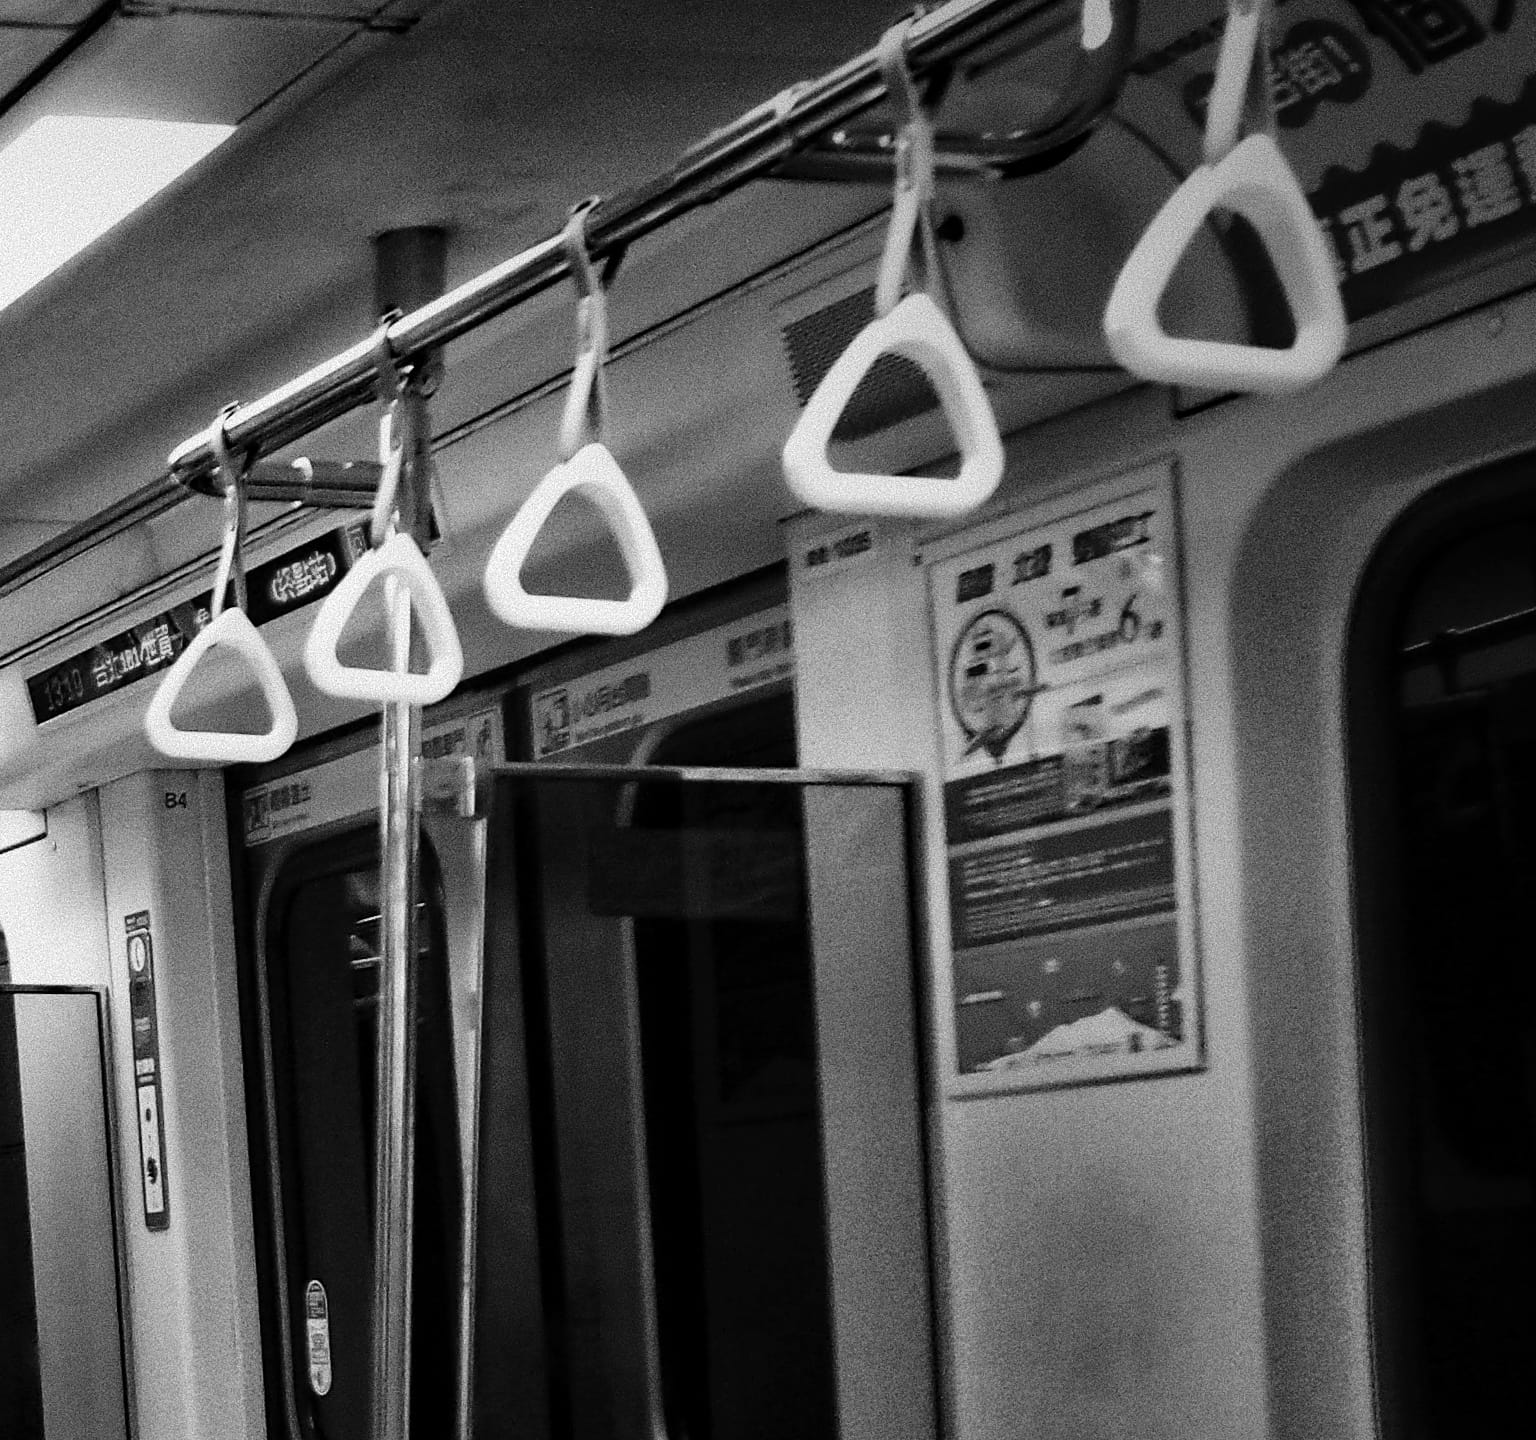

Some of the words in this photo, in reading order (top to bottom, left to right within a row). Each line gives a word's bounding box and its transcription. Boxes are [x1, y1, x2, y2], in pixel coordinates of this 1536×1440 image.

[1318, 125, 1536, 282] 正免運
[164, 792, 187, 809] B4
